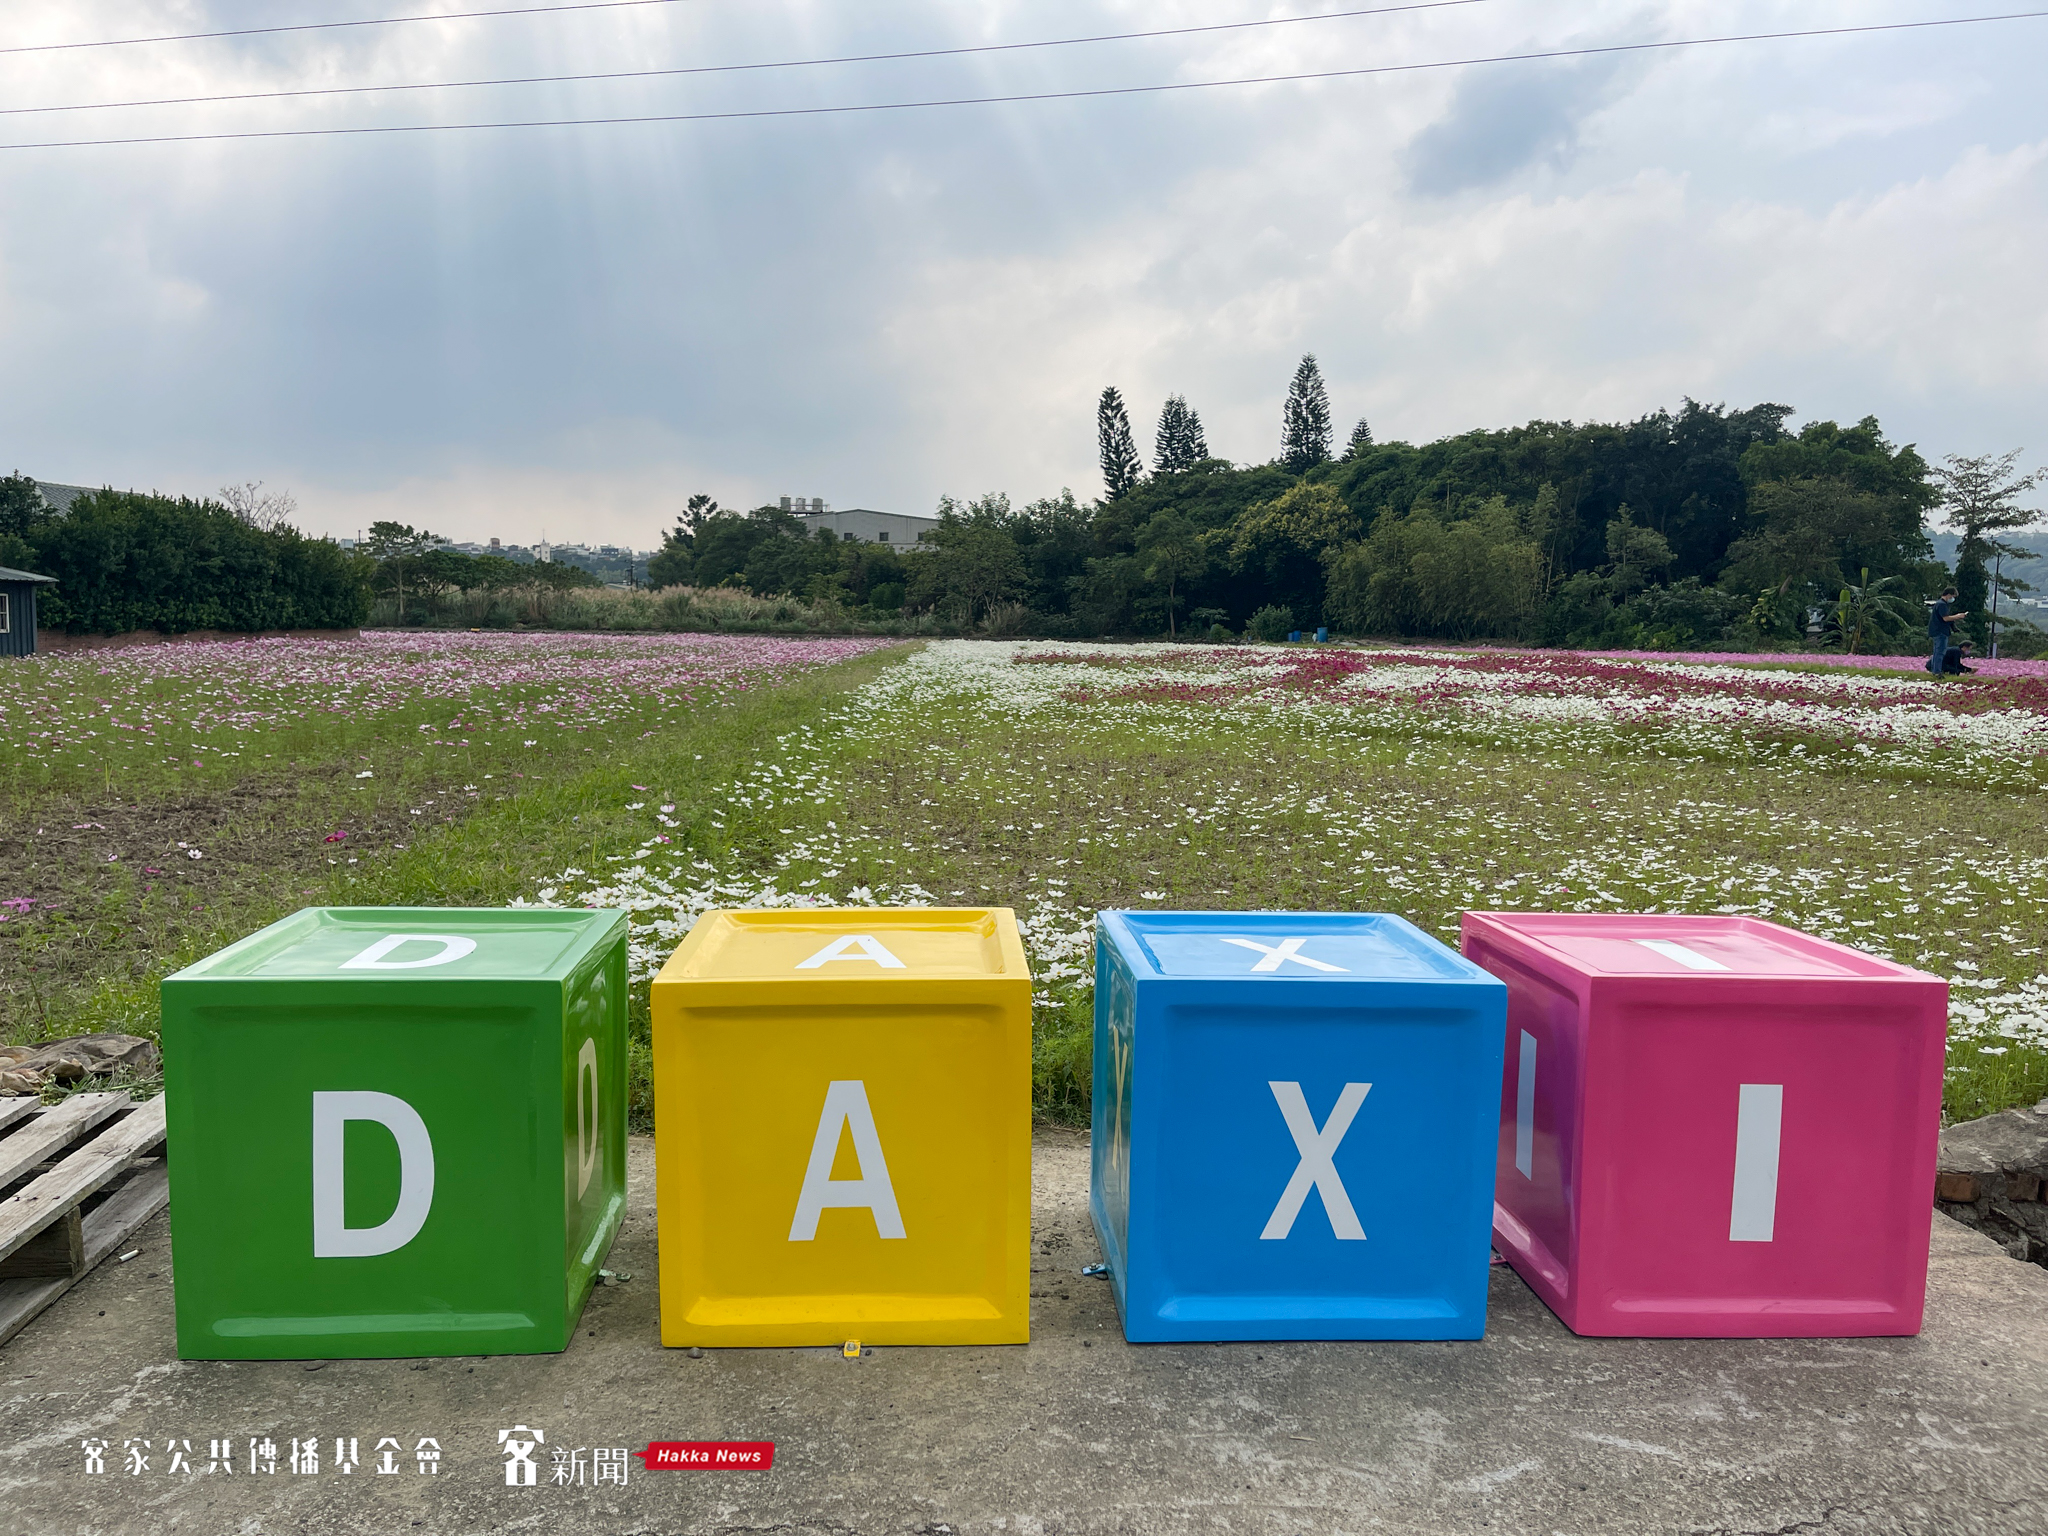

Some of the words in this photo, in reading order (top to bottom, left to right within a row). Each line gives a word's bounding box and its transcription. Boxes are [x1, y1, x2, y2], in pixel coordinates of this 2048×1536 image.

[338, 934, 477, 969] D
[794, 935, 907, 968] A
[1220, 938, 1351, 971] X
[312, 1090, 435, 1258] D
[577, 1037, 598, 1202] D
[788, 1080, 907, 1241] A
[1259, 1081, 1373, 1240] X
[1729, 1084, 1783, 1242] I
